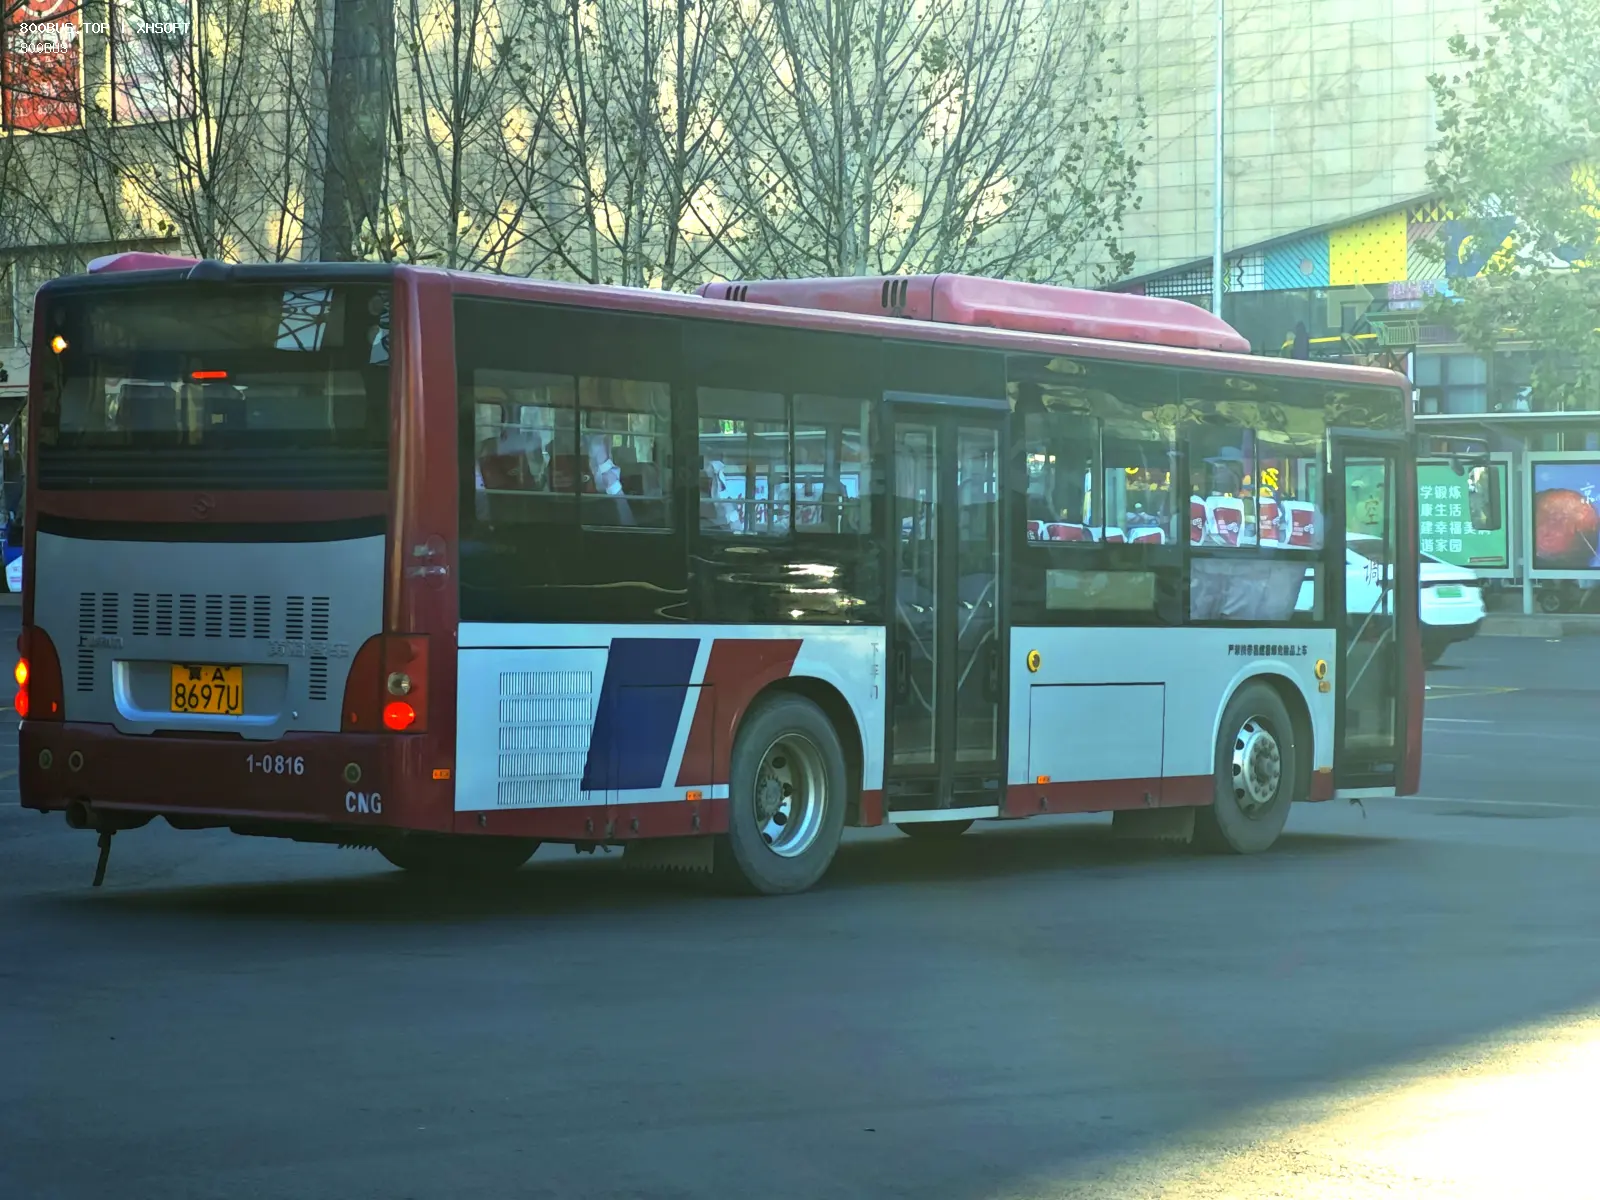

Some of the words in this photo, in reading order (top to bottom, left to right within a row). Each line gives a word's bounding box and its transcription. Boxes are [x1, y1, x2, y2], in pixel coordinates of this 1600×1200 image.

[174, 683, 239, 711] 8697U
[246, 754, 304, 775] 1-0816
[345, 791, 382, 814] CNG
